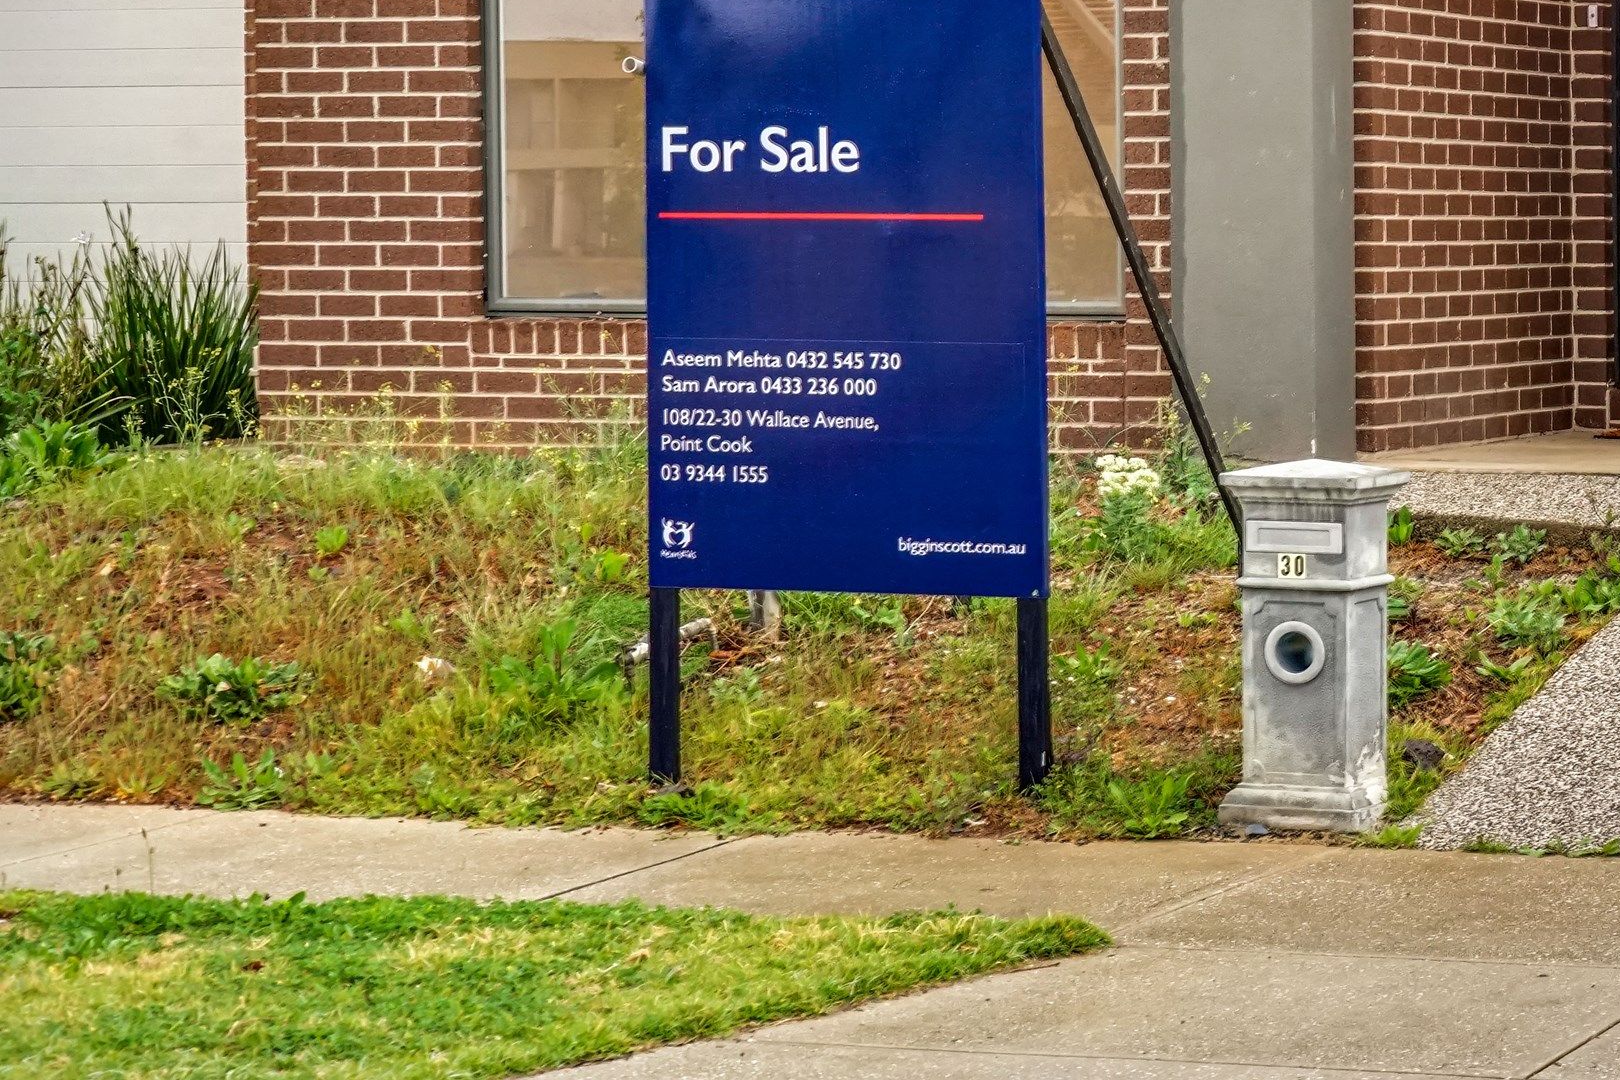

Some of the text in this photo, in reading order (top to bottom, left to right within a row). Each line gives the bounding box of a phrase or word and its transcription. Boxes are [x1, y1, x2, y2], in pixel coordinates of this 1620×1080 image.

[661, 125, 860, 173] For Sale
[660, 348, 902, 370] Aseem Mehta 0432 545 730
[661, 374, 877, 396] Sam Arora 0433 236 000
[663, 408, 880, 432] 108/22-30 Wallace Avenue,
[661, 433, 753, 453] Point Cook
[660, 463, 769, 484] 03 9344 1555
[898, 536, 1026, 556] bigginscott.com.au
[1281, 555, 1304, 576] 30
